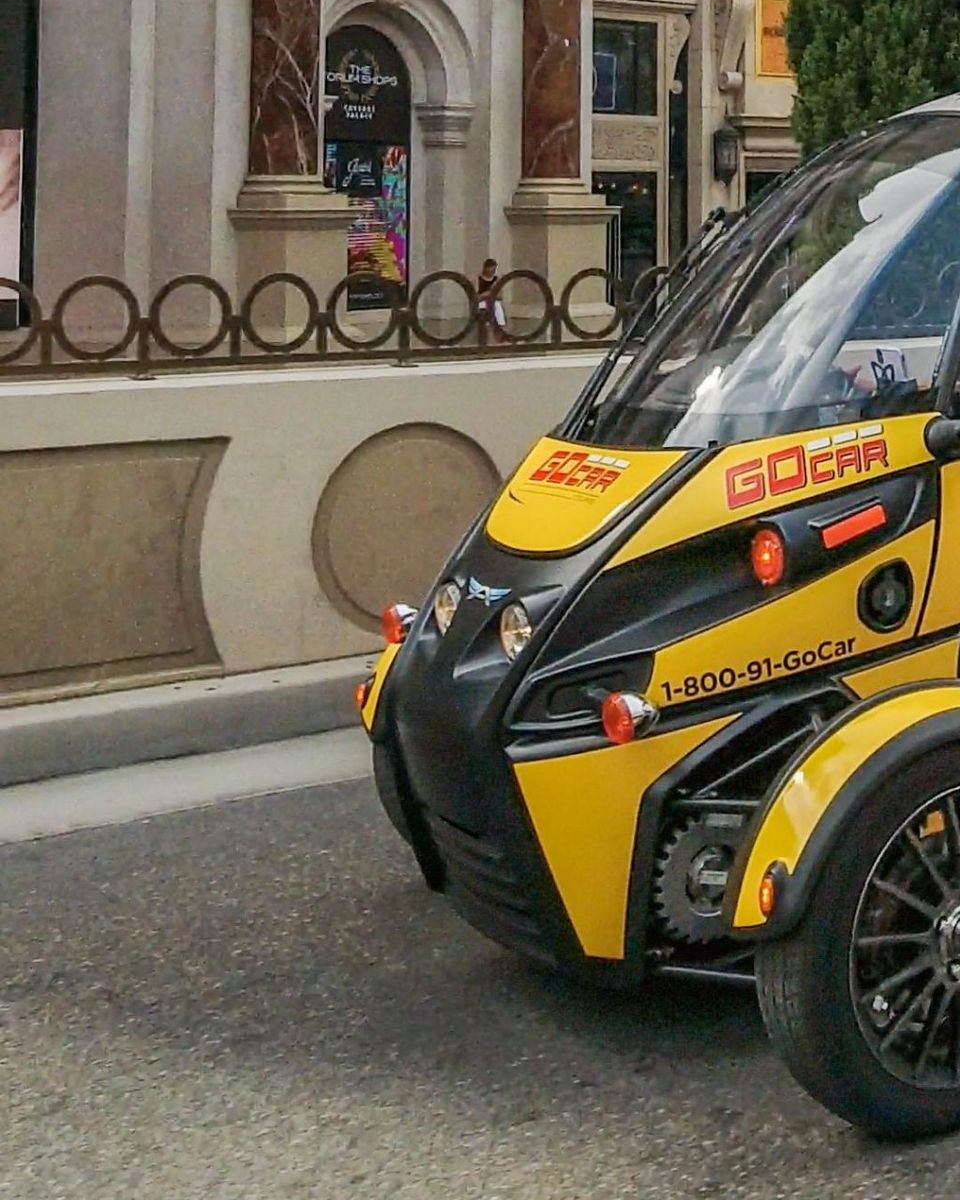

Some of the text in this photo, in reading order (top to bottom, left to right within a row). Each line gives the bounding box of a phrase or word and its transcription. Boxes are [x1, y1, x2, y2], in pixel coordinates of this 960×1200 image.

[529, 451, 620, 494] GOCAR
[725, 439, 888, 509] GOCAR
[660, 636, 856, 702] 1-800-91-GoCar
